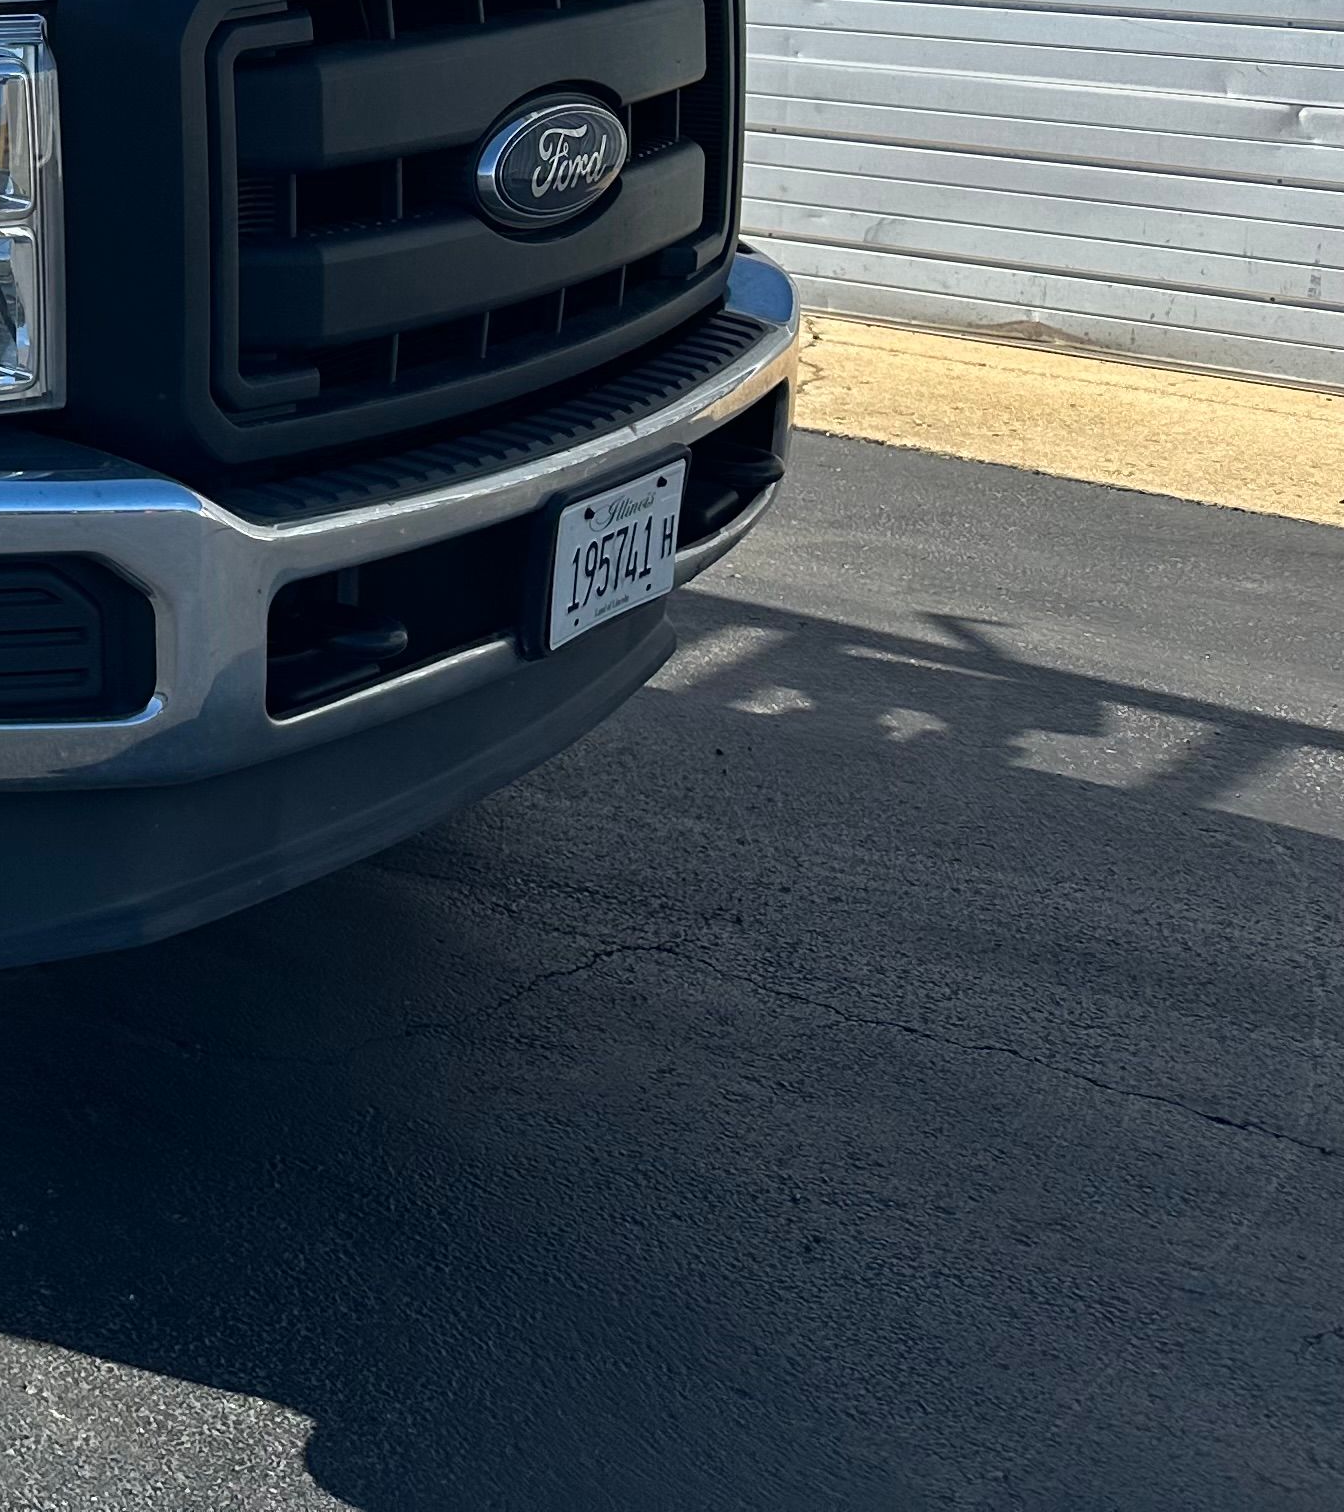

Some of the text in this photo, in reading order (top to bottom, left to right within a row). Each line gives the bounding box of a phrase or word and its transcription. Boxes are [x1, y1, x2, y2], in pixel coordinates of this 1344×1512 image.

[532, 124, 607, 198] Ford
[589, 491, 657, 532] Illinois
[567, 514, 675, 614] 195741 H
